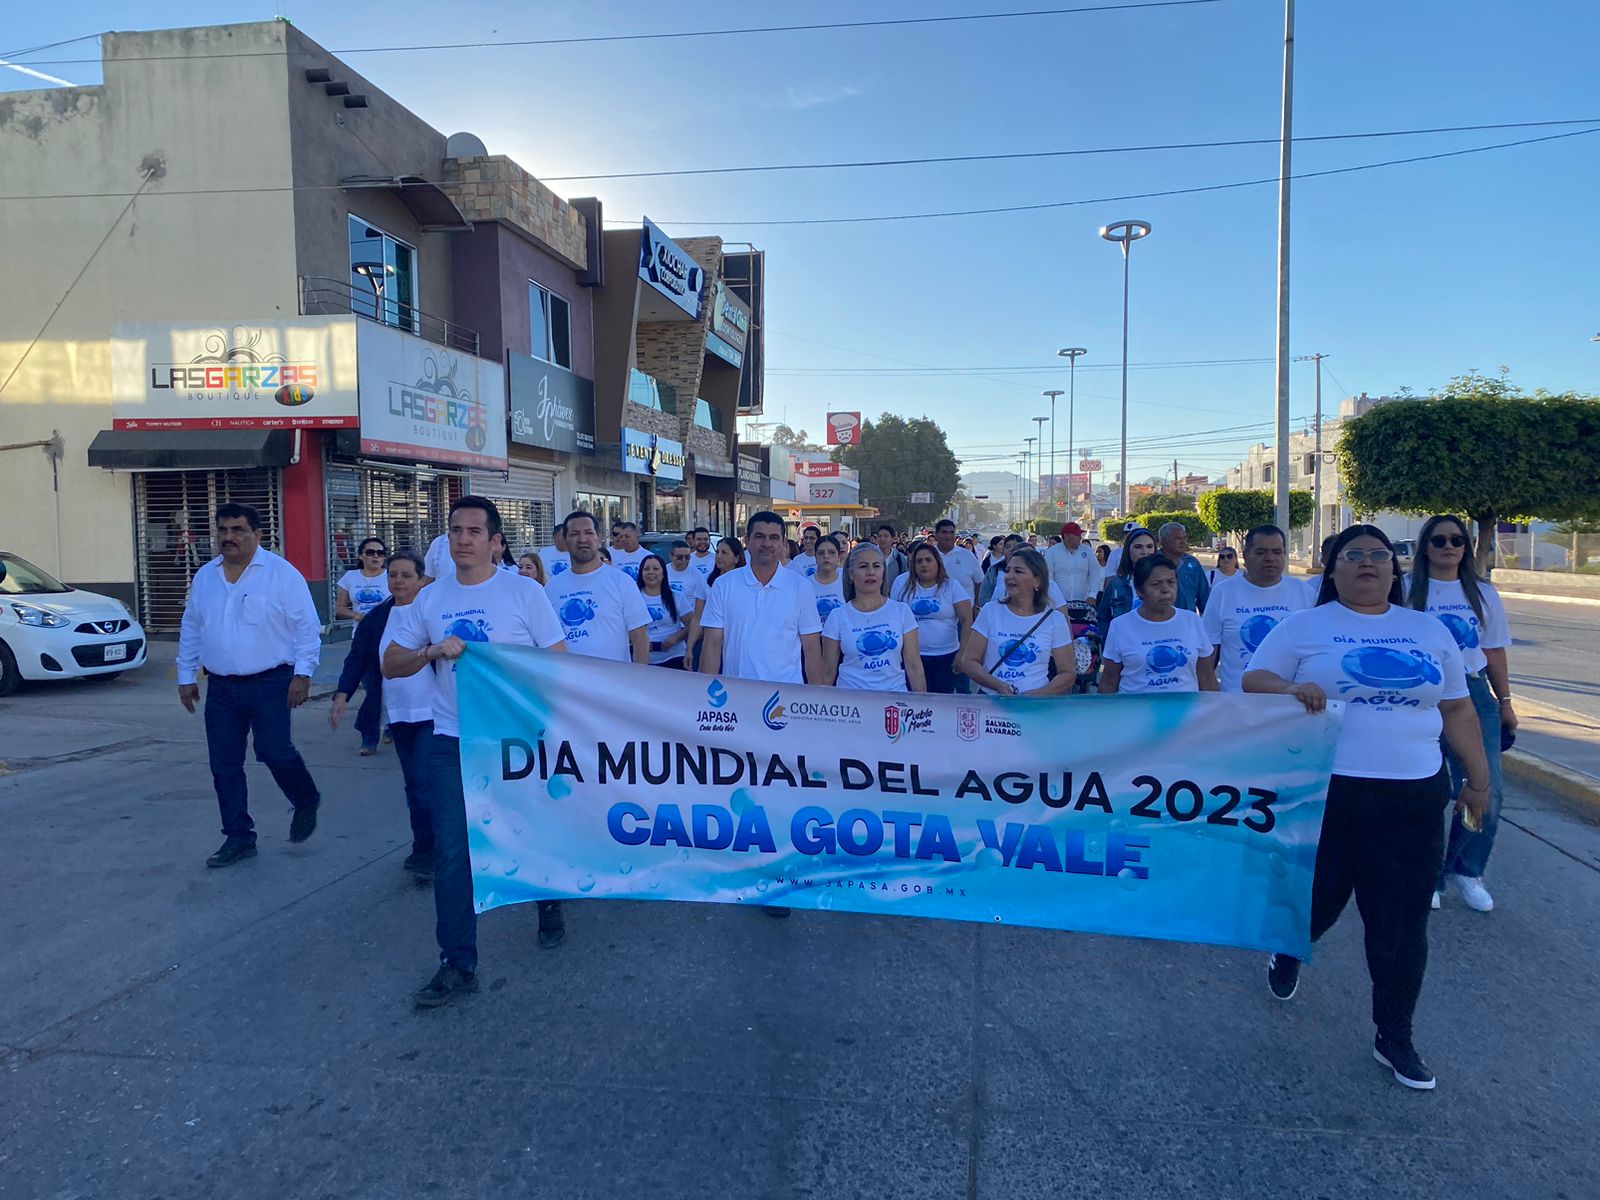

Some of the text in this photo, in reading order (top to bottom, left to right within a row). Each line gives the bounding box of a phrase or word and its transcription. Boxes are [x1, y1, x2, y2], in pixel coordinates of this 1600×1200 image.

[187, 392, 260, 401] BOUTIQUE
[413, 425, 459, 442] BOUTIQUE
[455, 607, 486, 617] MUNDIAL
[1332, 634, 1418, 645] DÍA MUNDIAL
[863, 659, 891, 670] AGUA
[996, 671, 1026, 679] AGUA
[1147, 676, 1180, 687] AGUA
[1349, 695, 1421, 708] AGUA
[789, 702, 861, 719] CONAGUA
[905, 708, 933, 723] Pueblo
[697, 710, 738, 724] JAPASA
[985, 726, 1022, 736] ALVARADO
[500, 729, 1279, 833] DÍA MUNDIAL DEL AGUA 2023
[606, 802, 1151, 881] CADA GOTA VALE
